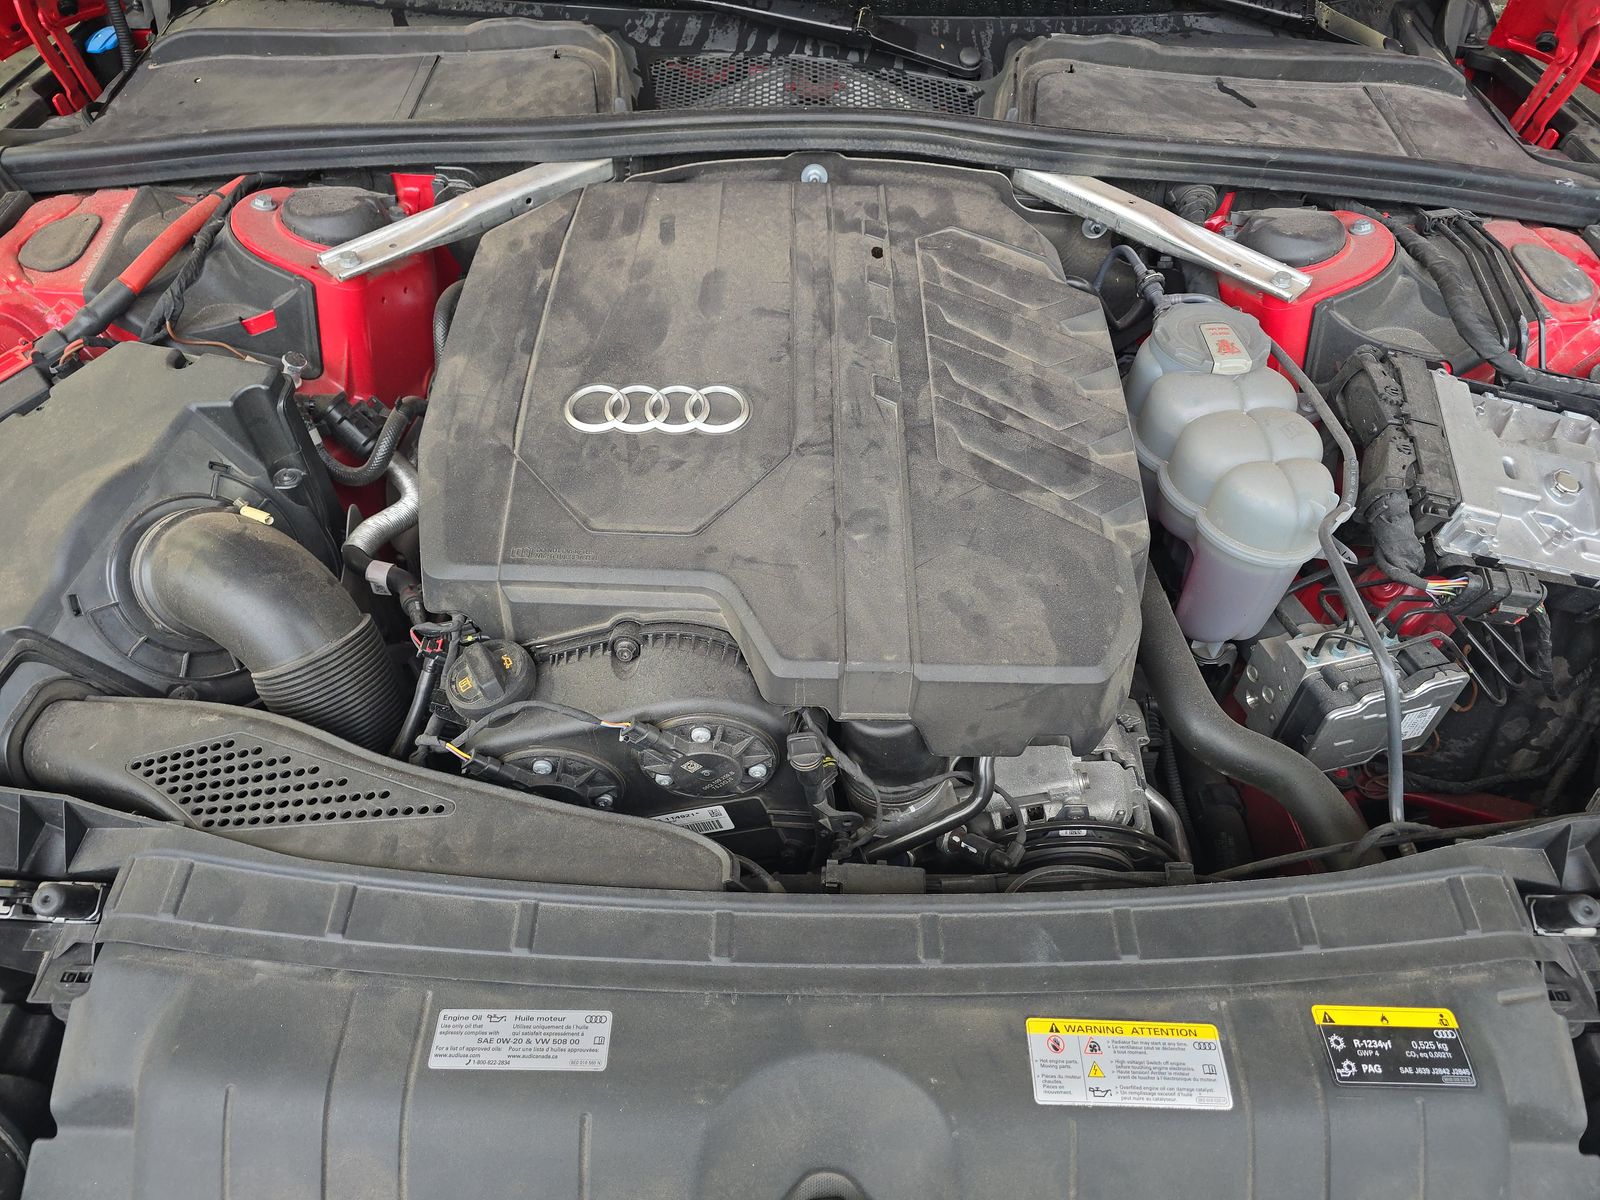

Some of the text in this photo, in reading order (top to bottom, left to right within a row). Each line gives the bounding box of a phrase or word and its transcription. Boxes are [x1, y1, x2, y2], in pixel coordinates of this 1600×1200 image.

[1064, 1024, 1198, 1037] WARNING ATTENTION
[1353, 1039, 1392, 1051] R-1234yf
[1411, 1040, 1449, 1051] 0,525 kg
[1361, 1064, 1382, 1074] PAG
